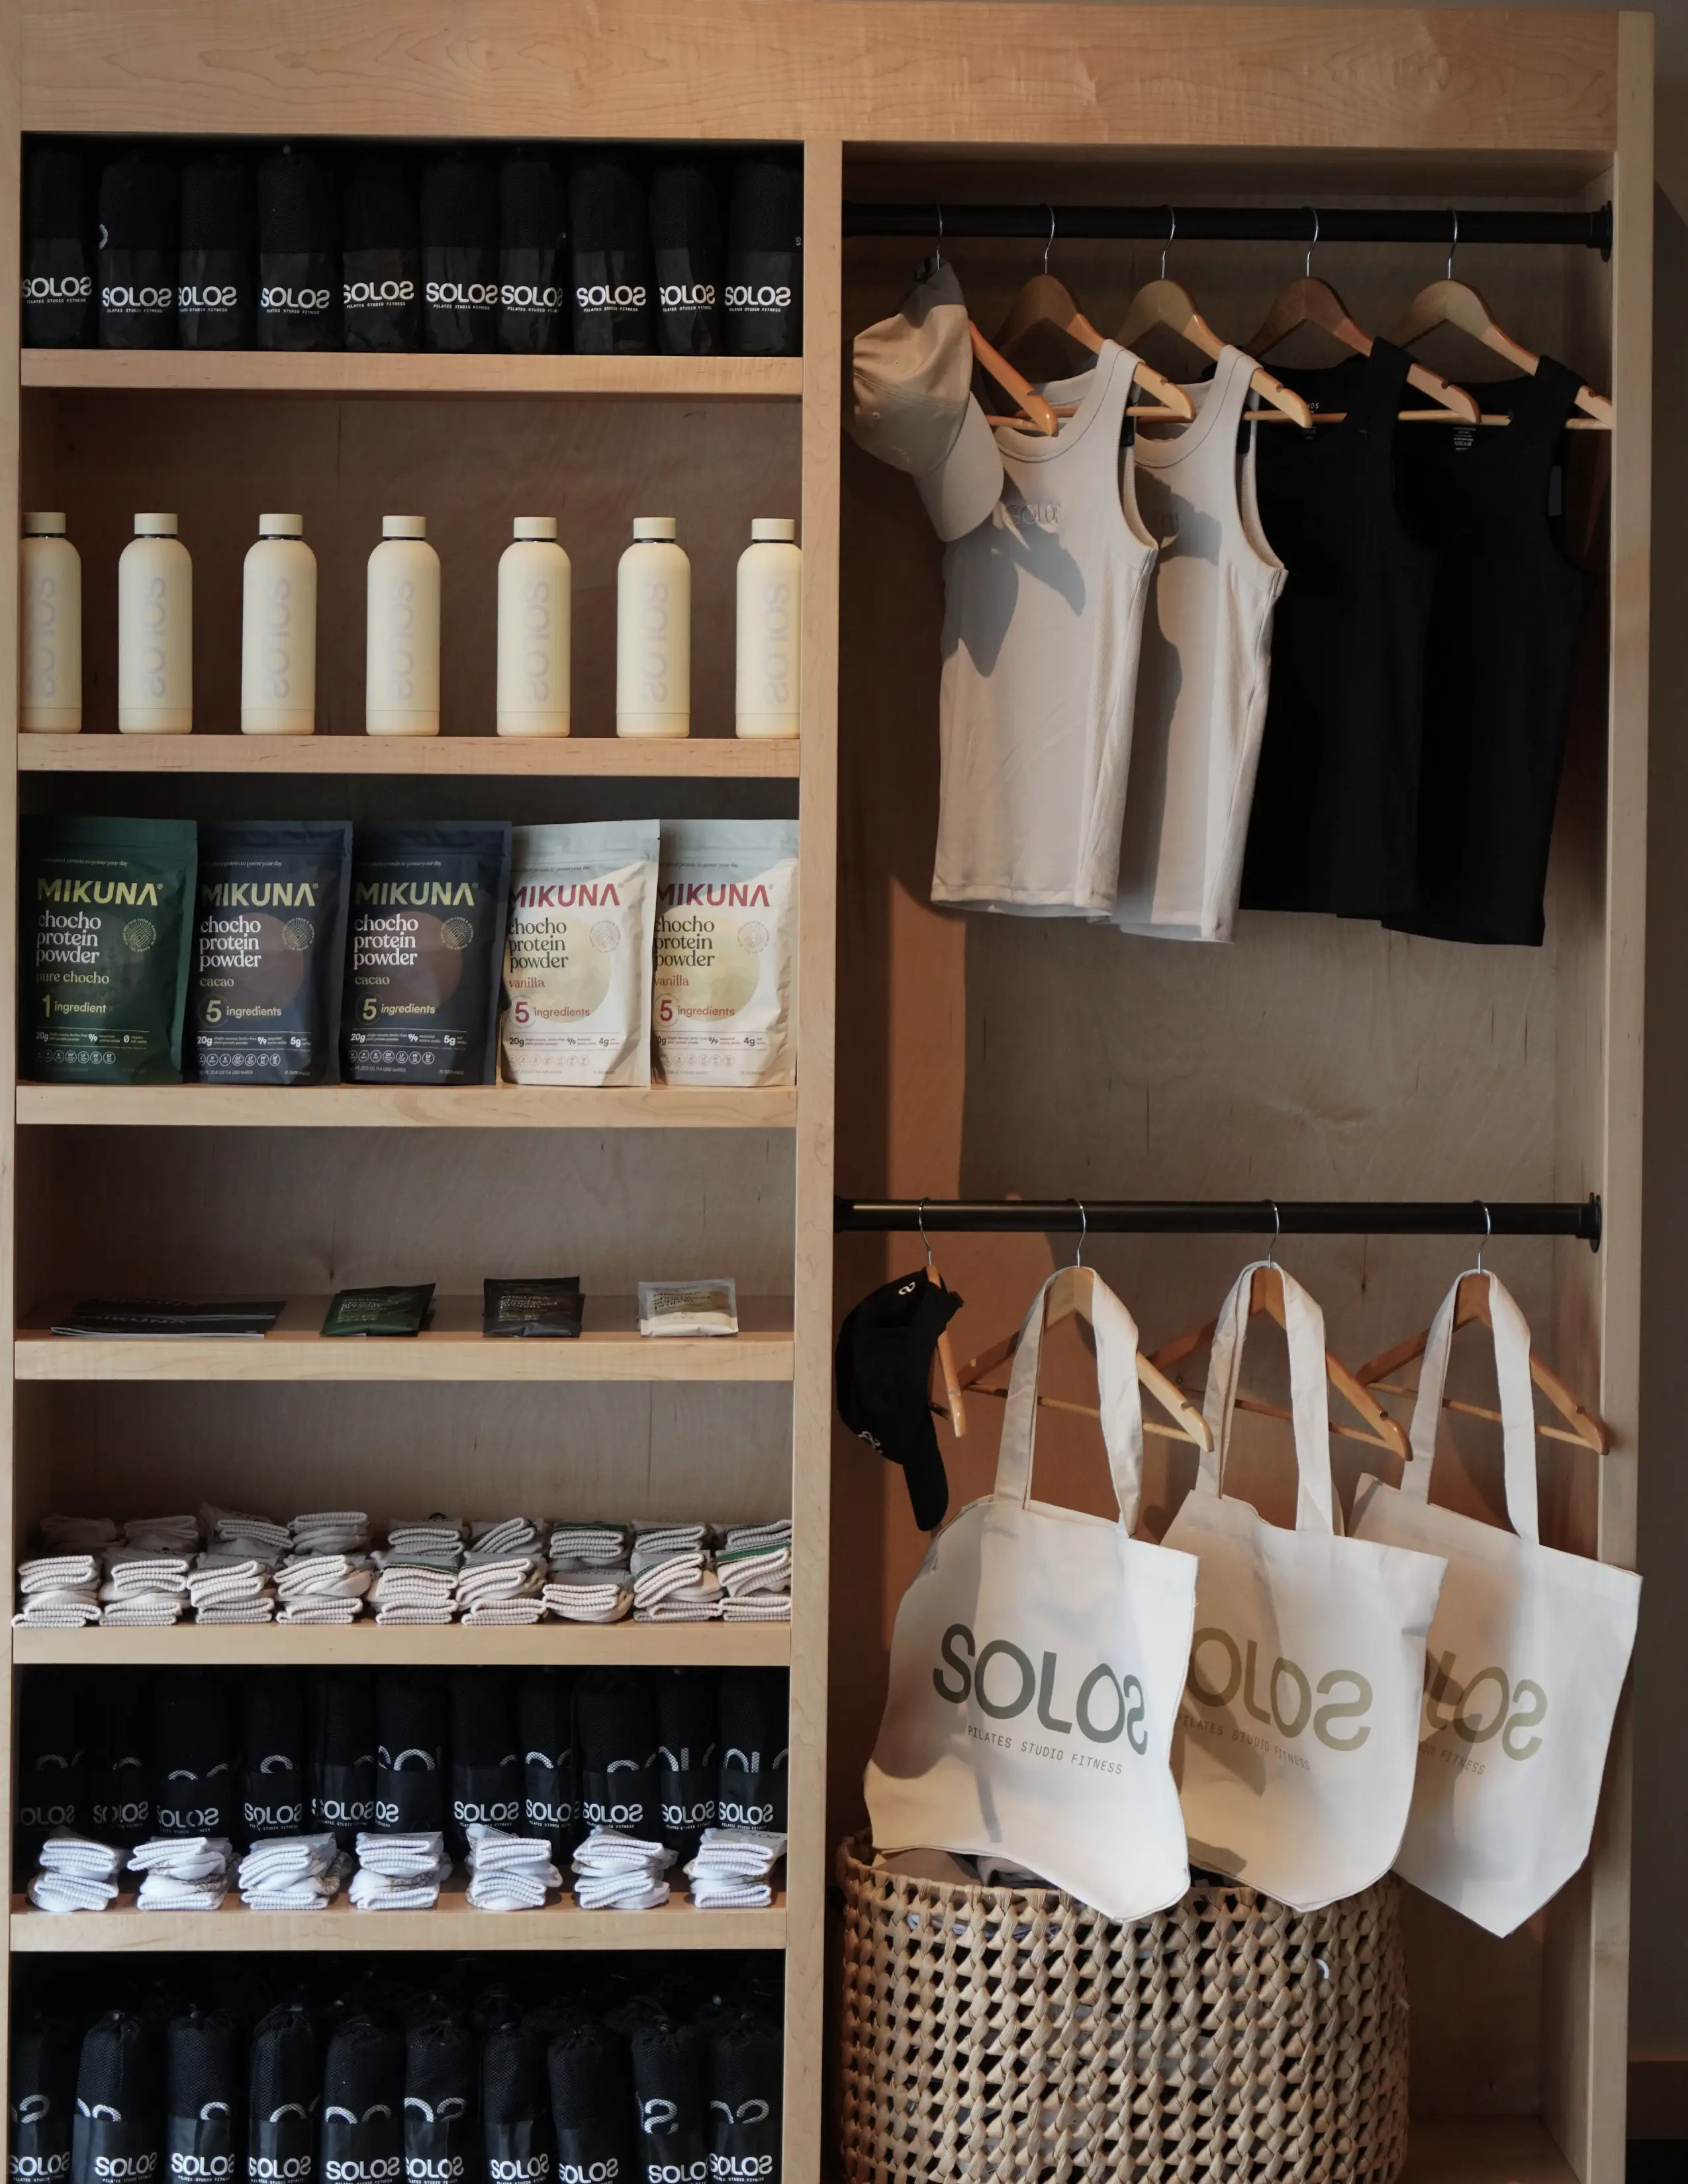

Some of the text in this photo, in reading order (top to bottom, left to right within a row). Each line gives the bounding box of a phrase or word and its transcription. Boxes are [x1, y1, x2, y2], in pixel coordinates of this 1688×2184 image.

[102, 287, 172, 308] SOLOS
[261, 287, 330, 308] SOLOS
[426, 282, 498, 304] SOLOS
[576, 285, 647, 306] SOLOS
[725, 286, 791, 306] SOLOS
[37, 878, 158, 906] MIKUNA
[38, 909, 101, 929] chocho
[201, 915, 261, 933] chocho
[355, 913, 418, 931] chocho
[509, 917, 567, 934] chocho
[655, 915, 715, 932] chocho
[37, 929, 99, 950] protein
[200, 933, 259, 954] protein
[354, 931, 416, 953] protein
[509, 935, 566, 952] protein
[655, 934, 713, 950] protein
[36, 946, 100, 966] powder
[200, 950, 262, 972] powder
[353, 948, 418, 970] powder
[510, 951, 569, 973] powder
[655, 950, 715, 971] powder
[36, 970, 110, 985] pure chocho
[200, 978, 234, 987] cacao
[355, 976, 391, 985] cacao
[509, 977, 545, 988] vanilla
[654, 975, 689, 986] vanilla
[42, 995, 107, 1017] 1 ingredient
[206, 1000, 282, 1023] 5 ingredients
[363, 998, 436, 1021] 5 ingredients
[515, 1001, 590, 1023] 5 ingredients
[660, 1000, 735, 1021] 5 ingredients
[36, 1032, 49, 1042] 20g
[197, 1036, 212, 1046] 20g
[290, 1036, 301, 1048] 5g
[351, 1033, 365, 1043] 20g
[444, 1035, 455, 1046] 5g
[509, 1037, 524, 1047] 20g
[599, 1037, 609, 1047] 4g
[657, 1036, 667, 1046] 0g
[743, 1036, 755, 1046] 4g
[933, 1623, 1148, 1755] SOLOS
[1186, 1627, 1373, 1752] OLOS
[1425, 1650, 1548, 1761] LOS
[968, 1725, 1123, 1775] PILATES STUDIO FITNESS
[1176, 1712, 1311, 1771] PILATES STUDIO FITNESS
[1440, 1749, 1485, 1776] FITNESS
[20, 1804, 75, 1827] OLOS
[244, 1802, 303, 1826] SOLOS
[454, 1801, 519, 1822] SOLOS
[718, 1801, 774, 1825] SOLOS
[95, 2152, 158, 2177] SOLOS
[171, 2152, 236, 2177] SOLOS
[326, 2156, 400, 2181] SOLOS
[491, 2153, 549, 2181] SOLOS
[648, 2158, 708, 2184] SOLO
[709, 2152, 773, 2177] SOLOS
